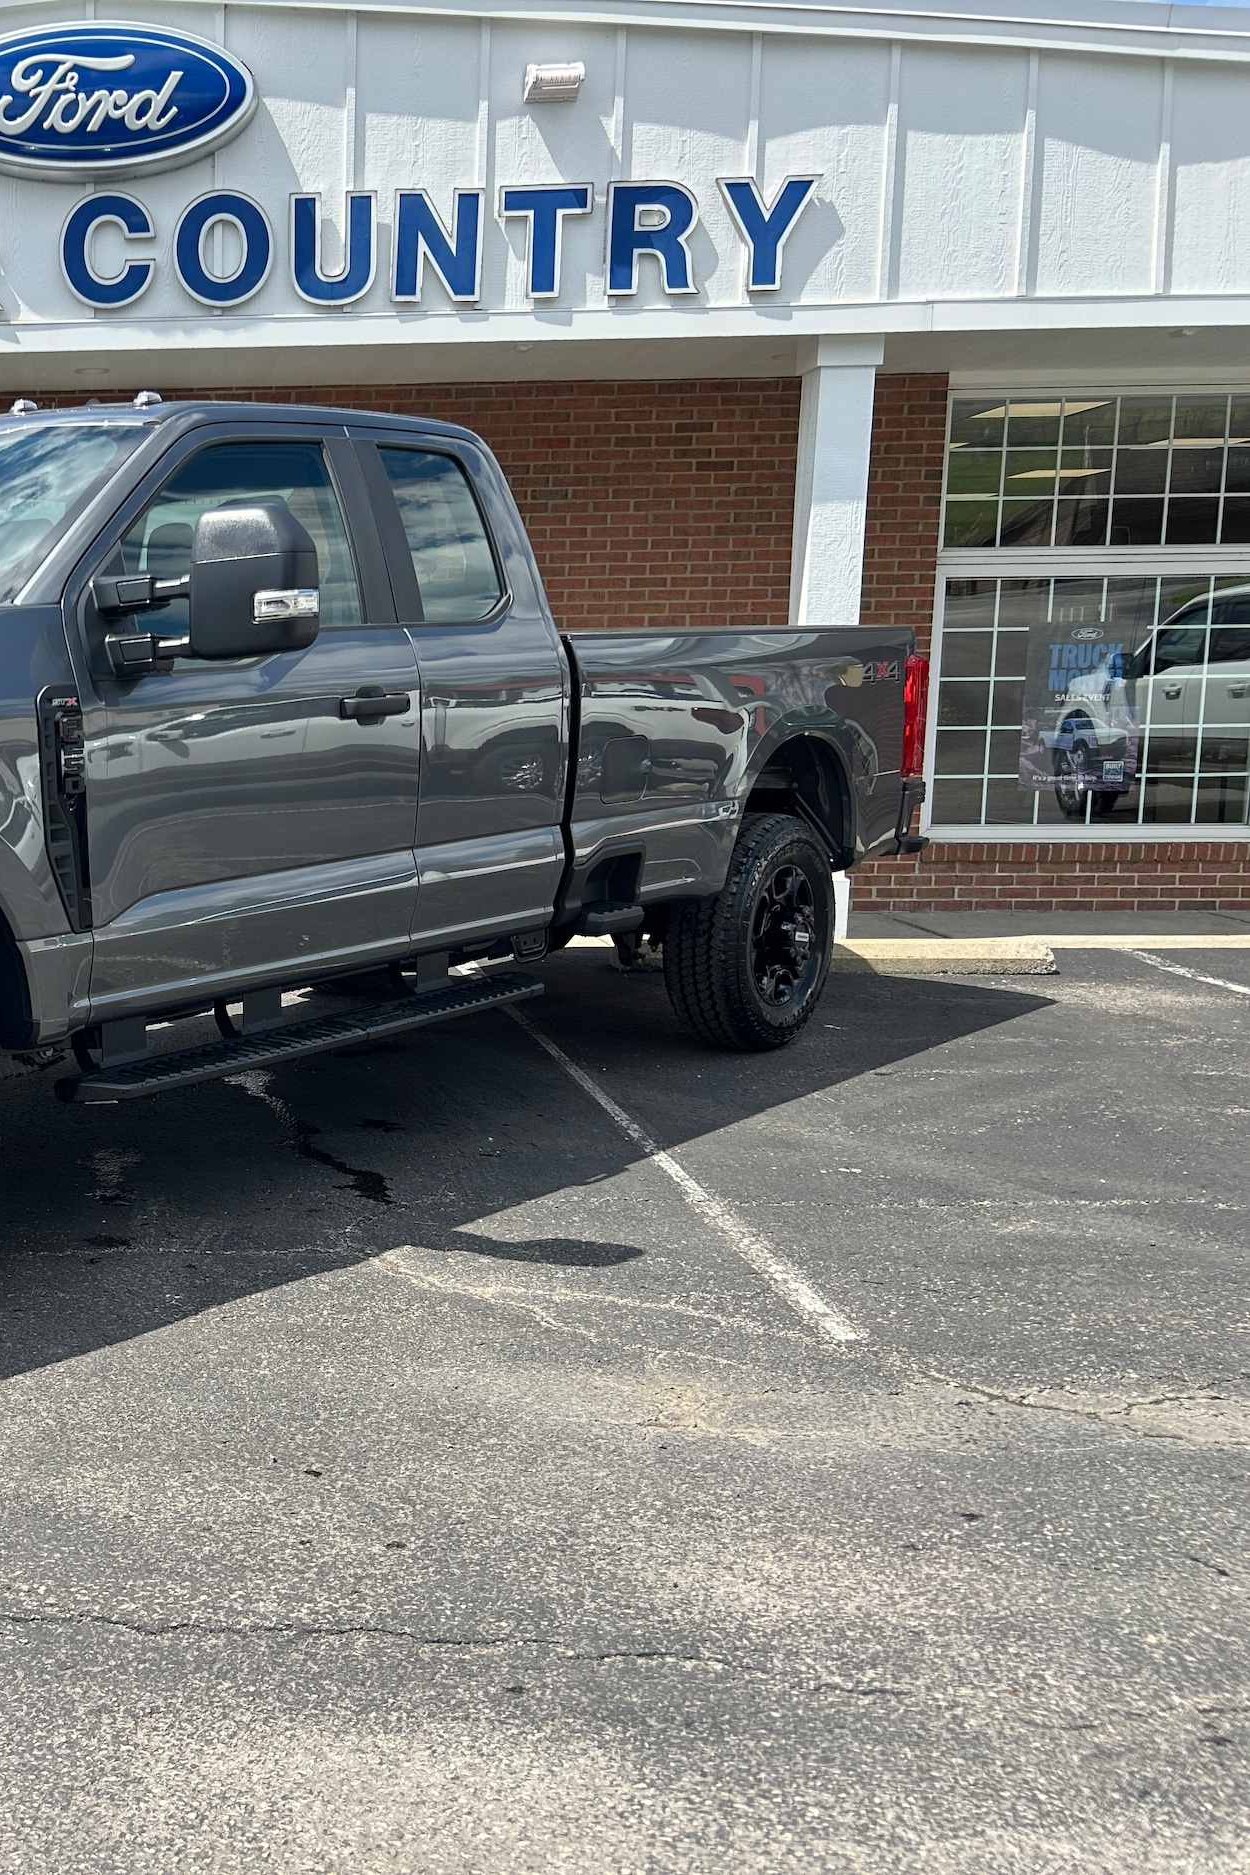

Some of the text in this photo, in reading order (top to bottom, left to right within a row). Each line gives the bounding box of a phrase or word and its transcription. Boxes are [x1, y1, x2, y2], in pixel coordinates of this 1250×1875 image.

[59, 174, 824, 308] COUNTRY
[1049, 643, 1124, 668] TRUCK
[1054, 693, 1111, 702] SALES EVENT
